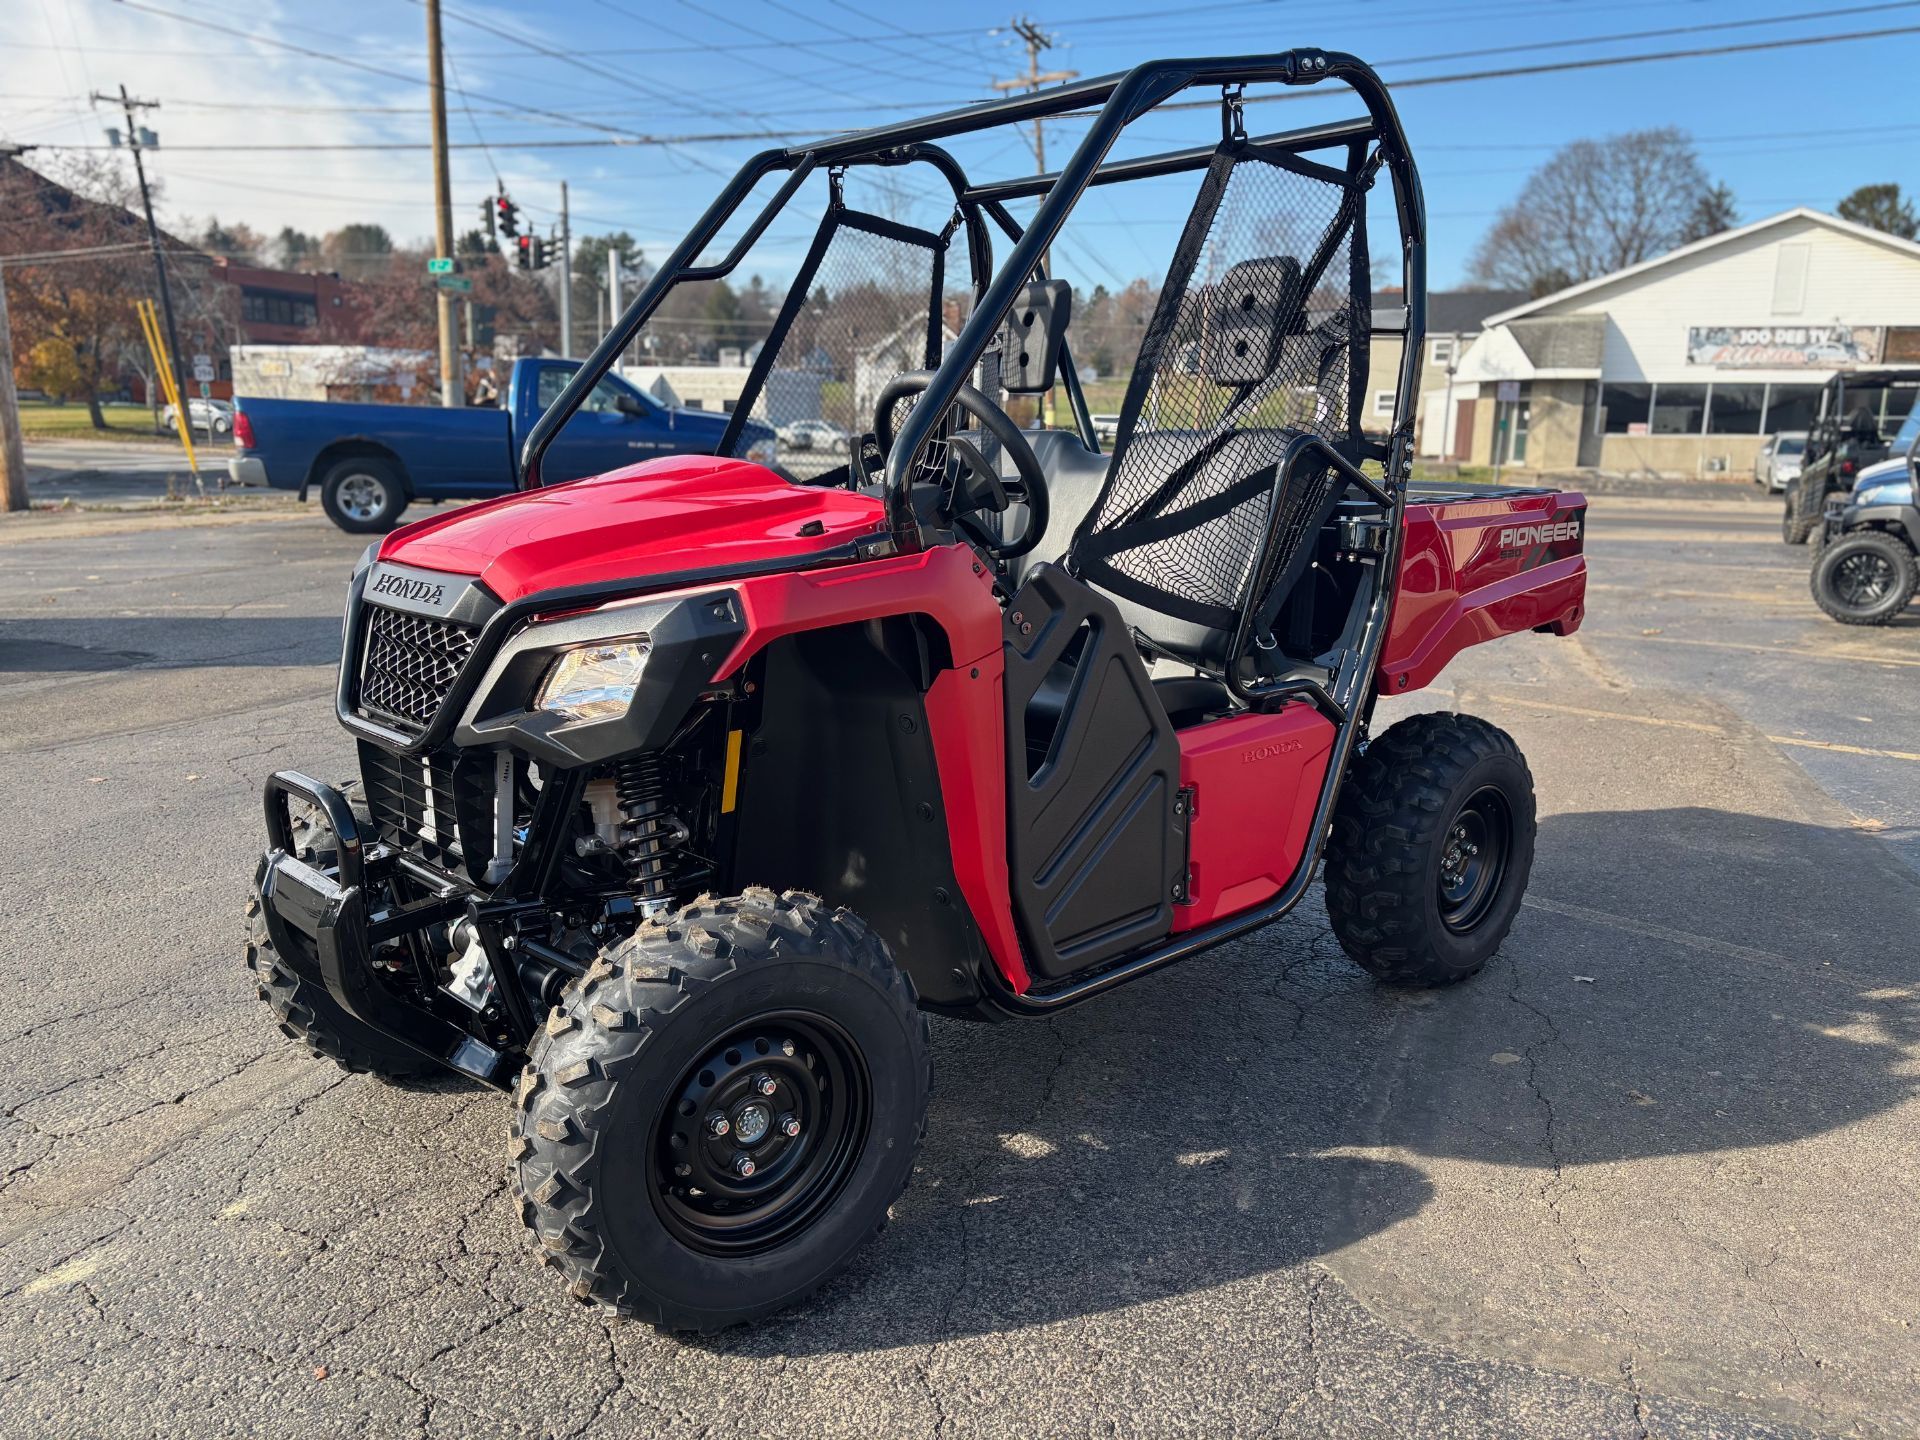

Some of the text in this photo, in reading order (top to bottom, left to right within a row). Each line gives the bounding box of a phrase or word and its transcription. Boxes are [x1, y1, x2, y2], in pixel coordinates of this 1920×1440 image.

[1500, 522, 1580, 548] PIONEER
[372, 573, 446, 605] HONDA
[1241, 739, 1303, 765] HONDA
